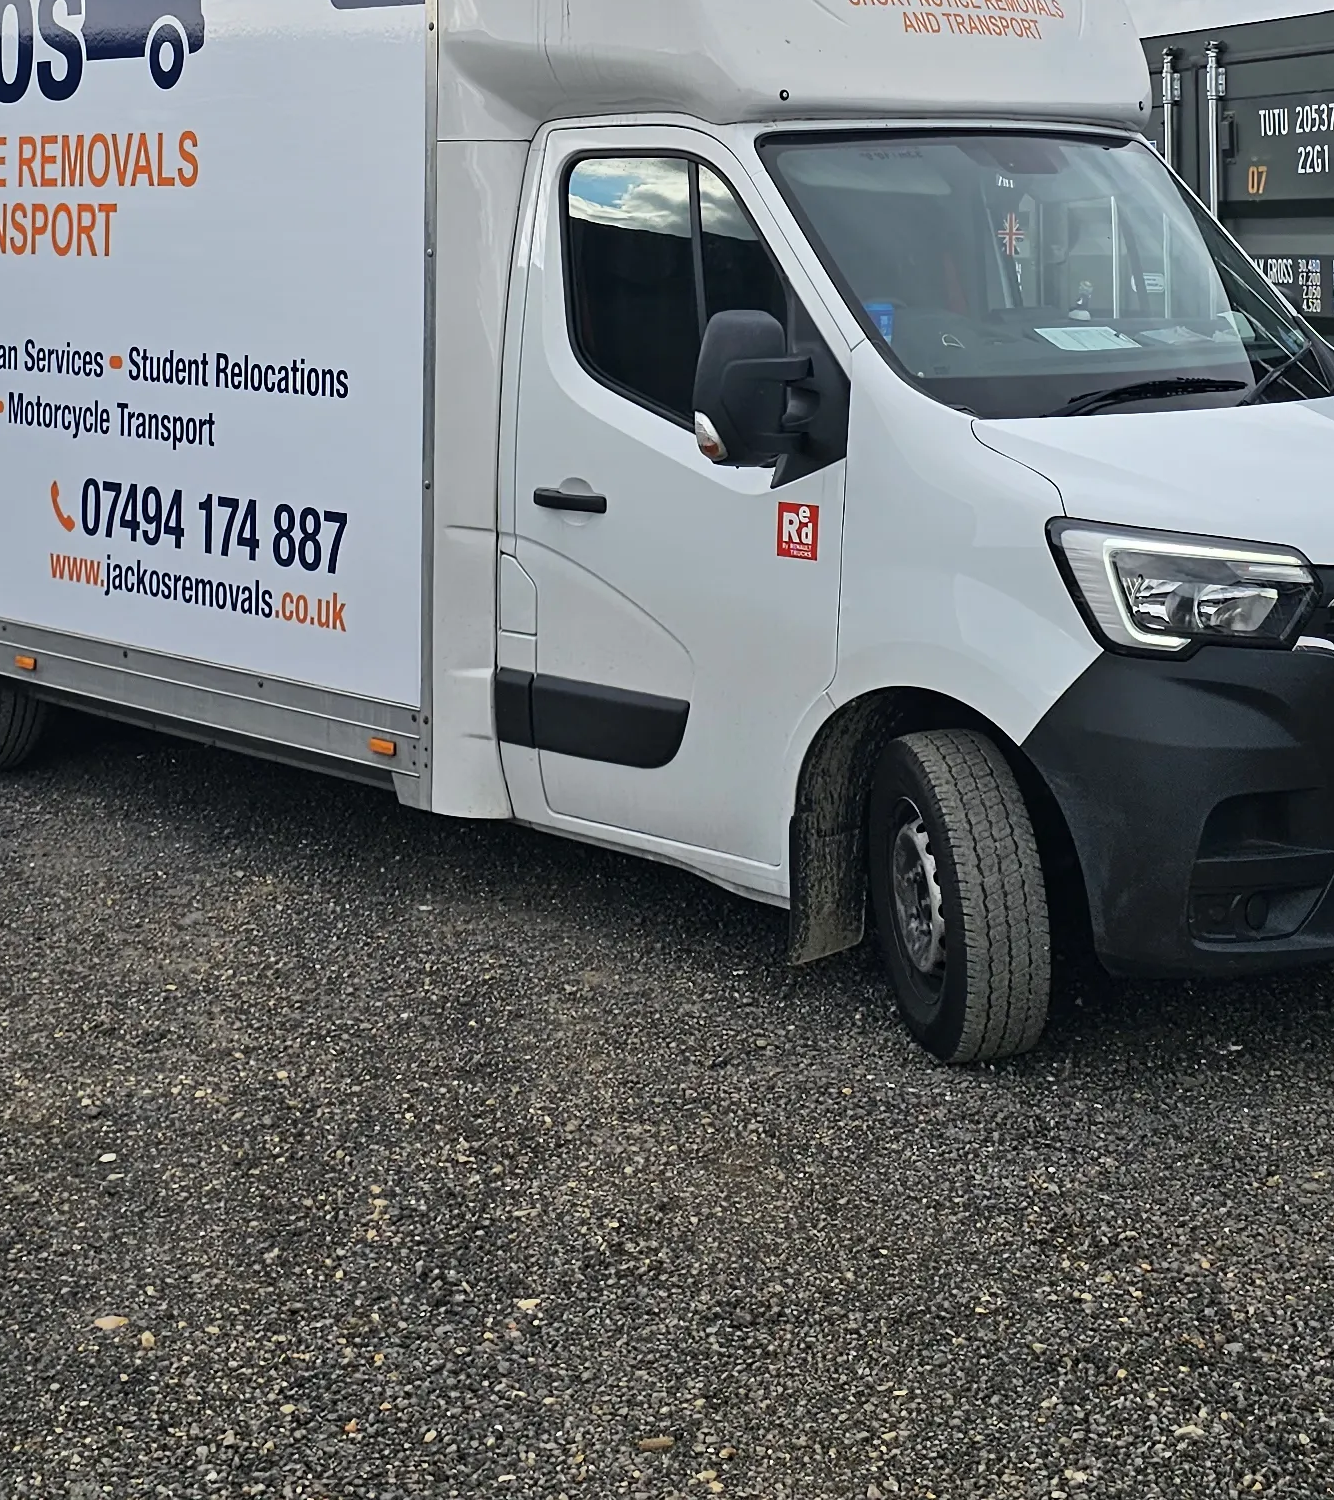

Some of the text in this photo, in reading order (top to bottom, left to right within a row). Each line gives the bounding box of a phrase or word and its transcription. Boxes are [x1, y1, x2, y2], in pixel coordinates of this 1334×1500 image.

[902, 11, 1043, 40] AND TRANSPORT
[1258, 108, 1288, 137] TUTU
[19, 131, 199, 188] REMOVALS
[1297, 144, 1329, 174] 22G1
[1248, 166, 1267, 194] 07
[1267, 258, 1294, 284] GROSS
[1298, 272, 1321, 286] 67.200
[1302, 286, 1322, 299] 2.050
[1302, 299, 1321, 313] 4.520
[24, 338, 104, 378] Services
[128, 346, 208, 387] Student
[216, 352, 349, 399] Relocations
[8, 391, 110, 439] Motorcycle
[116, 402, 215, 450] Transport
[81, 478, 348, 575] 07494 174 887
[50, 553, 347, 632] www.jackosremovals.co.uk
